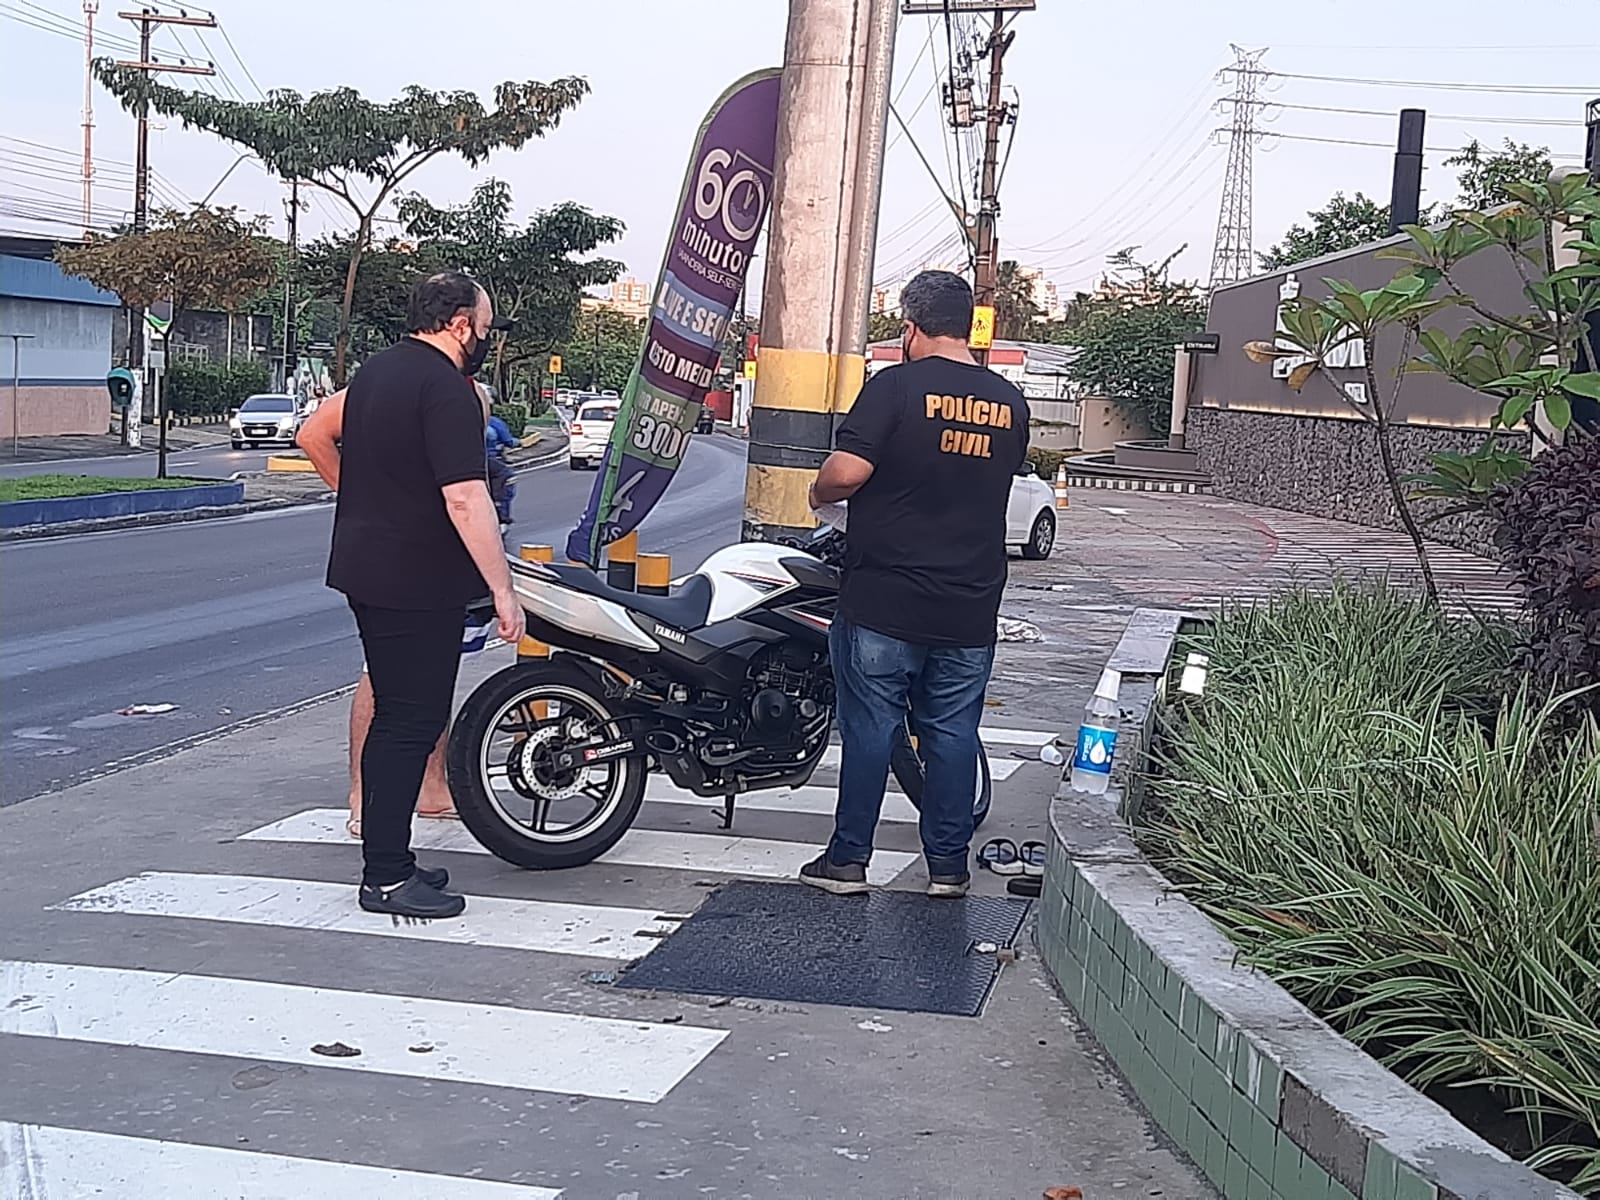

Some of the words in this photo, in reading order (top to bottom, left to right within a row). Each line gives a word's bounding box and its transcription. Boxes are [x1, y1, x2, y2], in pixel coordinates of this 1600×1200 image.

[694, 148, 765, 241] 60
[925, 394, 1013, 430] POLÍCIA
[940, 428, 992, 459] CIVIL
[655, 623, 686, 645] YAMAHA
